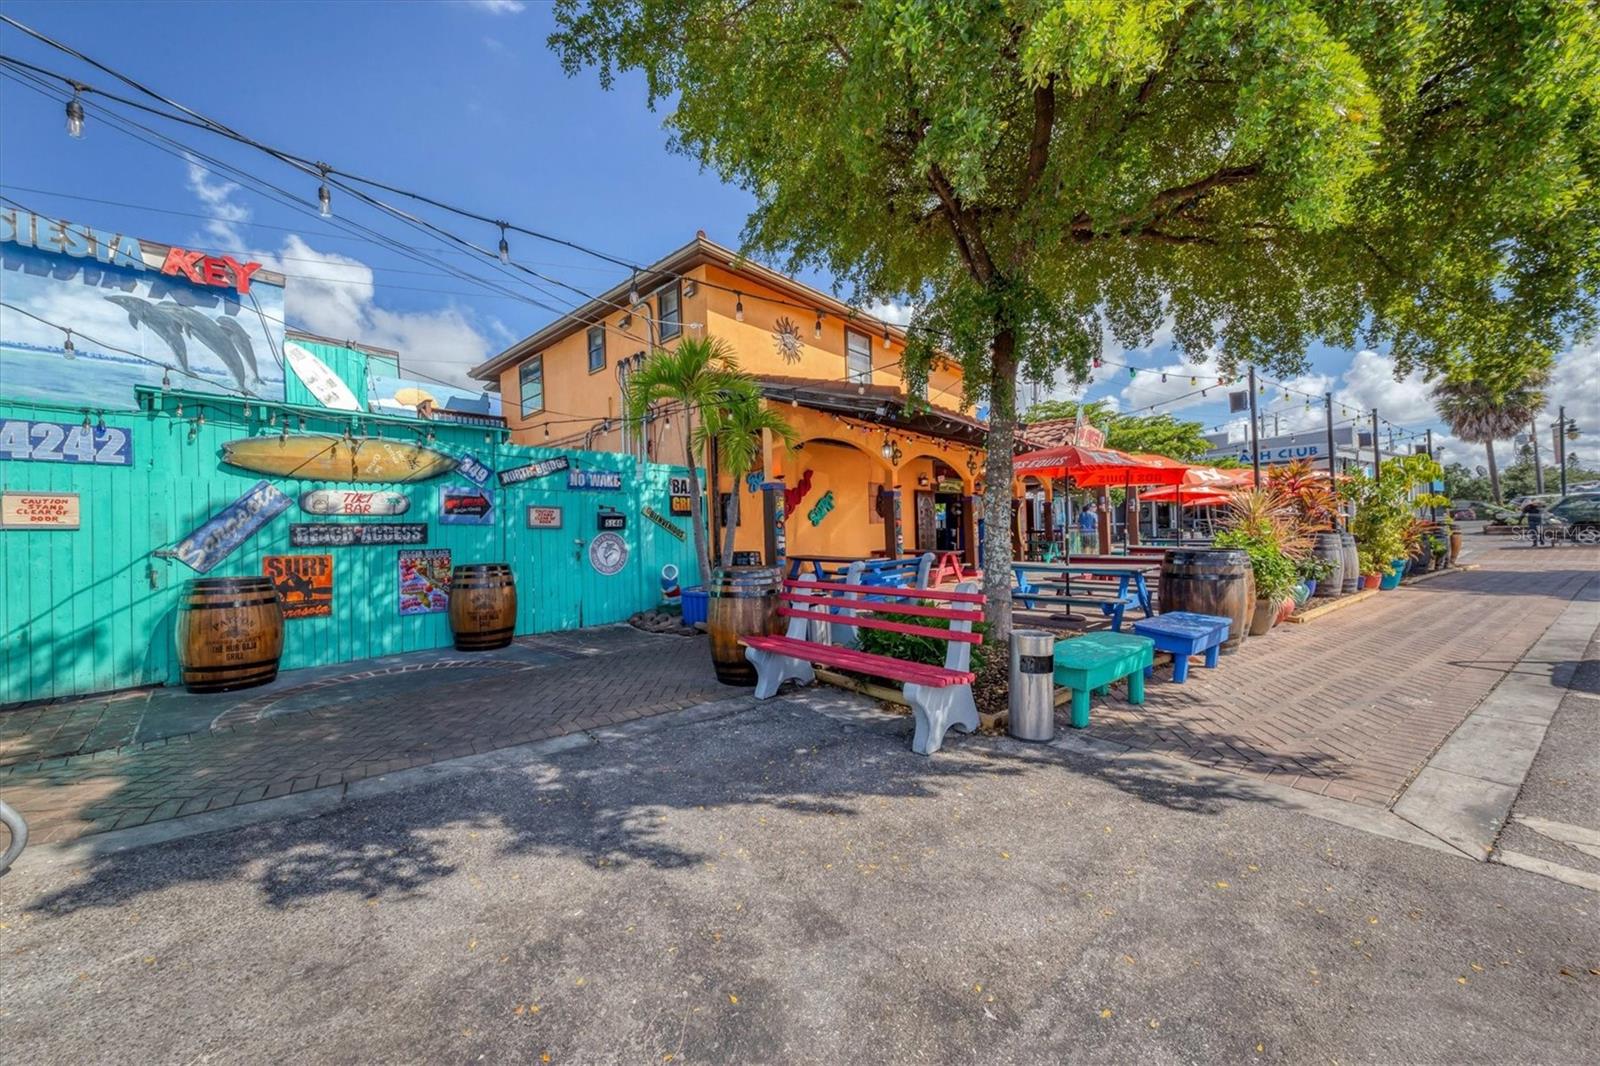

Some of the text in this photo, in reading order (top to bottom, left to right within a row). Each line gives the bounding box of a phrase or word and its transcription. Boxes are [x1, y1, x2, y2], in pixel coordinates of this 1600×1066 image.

[0, 206, 262, 295] SIESTA KEY
[1, 420, 126, 464] 4242
[1279, 446, 1318, 459] CLUB
[502, 457, 568, 484] NORTH BRIDGE
[570, 473, 621, 487] NO WAKE
[672, 479, 690, 494] BA
[344, 492, 374, 503] TIKI
[672, 497, 690, 511] GRI
[345, 503, 372, 514] BAR
[295, 526, 421, 544] BEACH ACCESS
[268, 557, 328, 576] SURF
